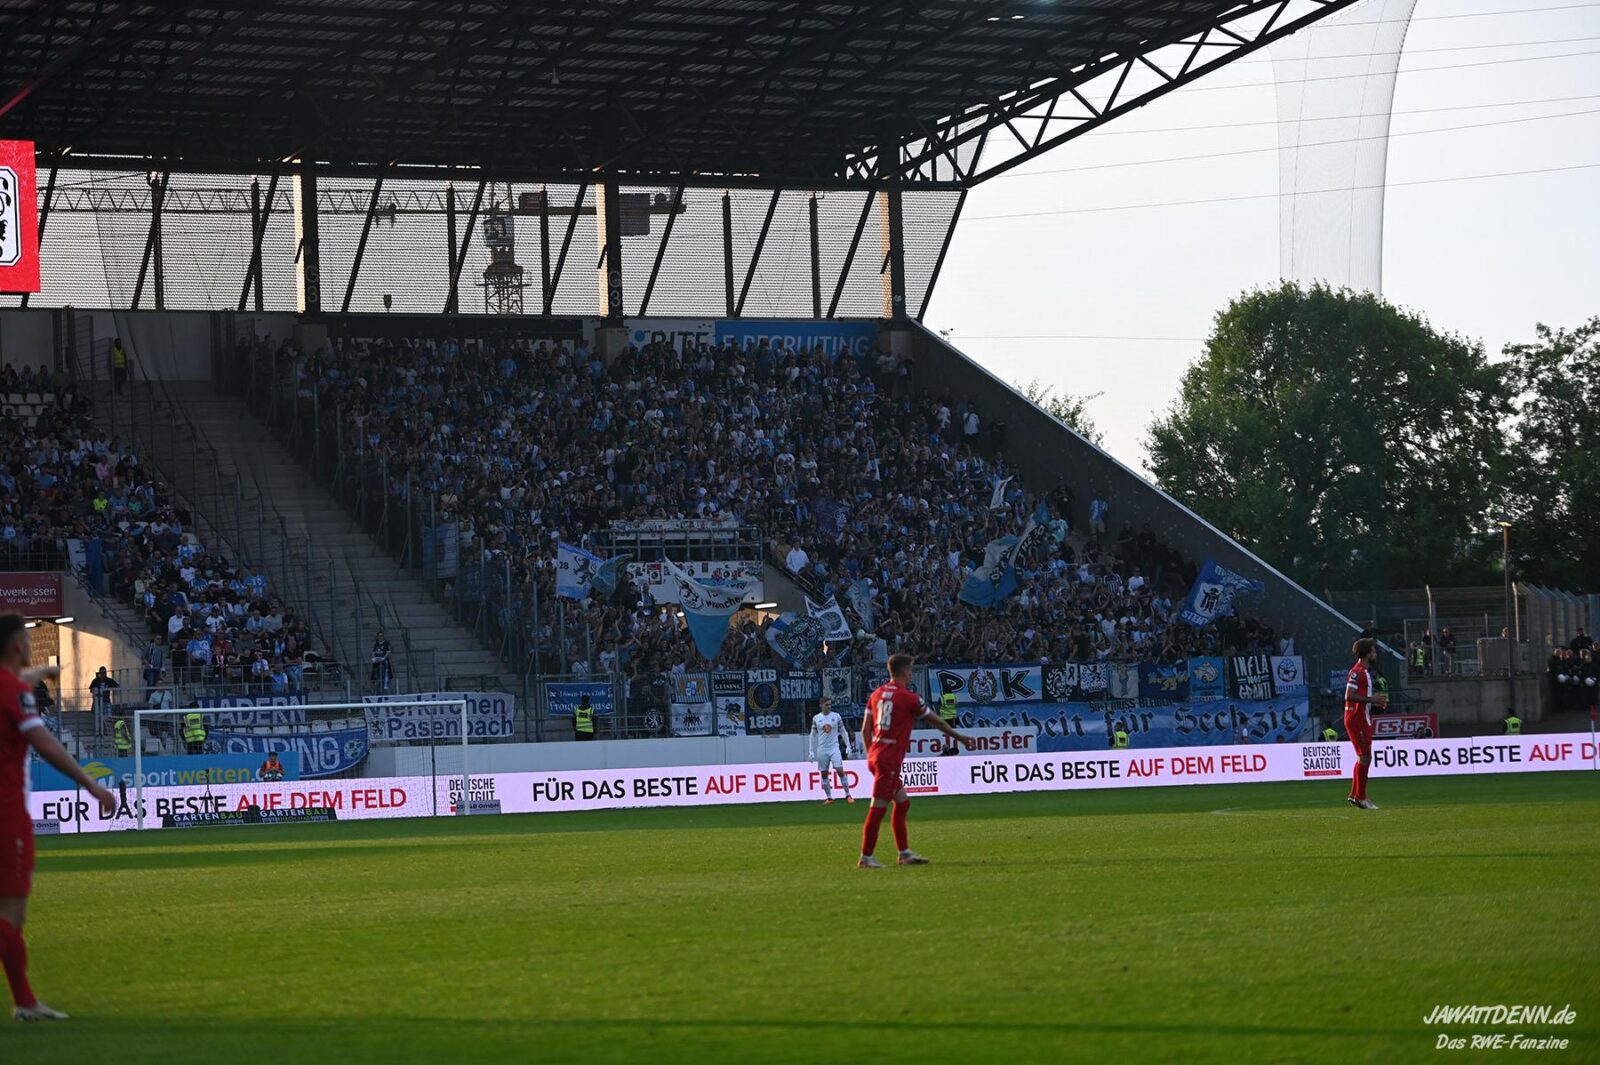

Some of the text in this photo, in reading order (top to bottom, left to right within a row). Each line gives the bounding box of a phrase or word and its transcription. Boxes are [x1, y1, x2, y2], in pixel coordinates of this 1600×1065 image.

[747, 669, 777, 682] MIB
[387, 715, 514, 738] Pasenbach
[749, 715, 782, 729] 1860
[1302, 745, 1341, 758] DEUTSCHE
[1374, 742, 1600, 768] FÜR DAS BESTE AUF D
[902, 761, 938, 773] EUTSCHE
[970, 753, 1267, 784] FÜR DAS BESTE AUF DEM FELD
[1303, 757, 1342, 770] SAATGUT
[121, 766, 264, 788] sportwetten.
[533, 777, 575, 802] FÜR
[582, 778, 626, 799] DAS
[633, 776, 698, 797] BESTE
[705, 774, 747, 795] AUF
[754, 772, 802, 792] DEM
[450, 790, 495, 805] SATGUT
[43, 797, 90, 823] FÜR
[351, 788, 407, 809] FELD
[260, 808, 328, 817] GARTENBAU
[173, 812, 243, 821] GARTENBAU
